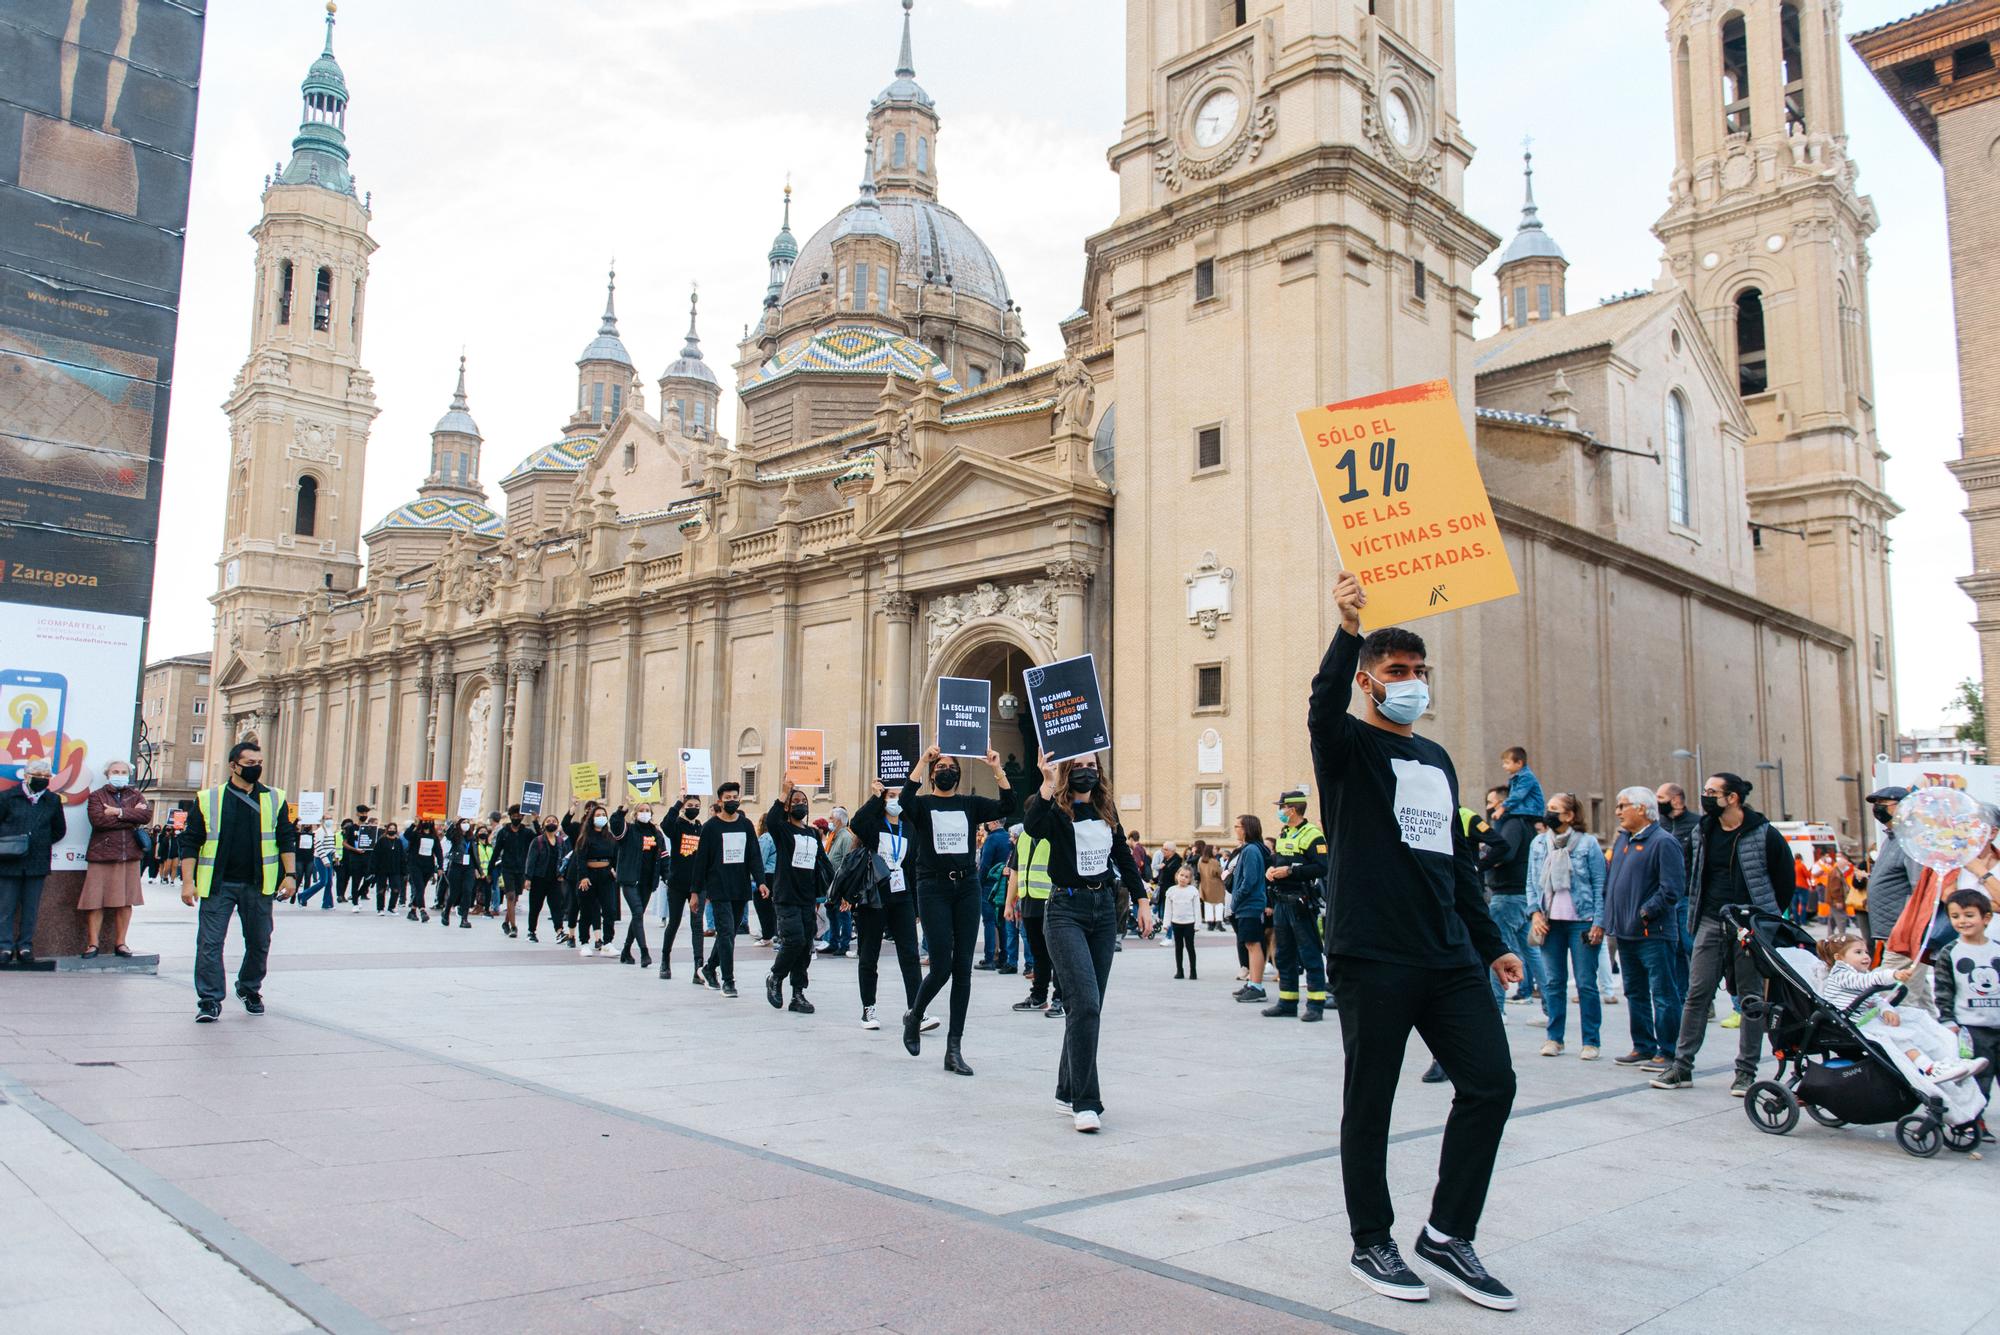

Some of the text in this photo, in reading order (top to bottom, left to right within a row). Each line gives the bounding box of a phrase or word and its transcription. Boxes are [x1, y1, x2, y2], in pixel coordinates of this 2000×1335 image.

[26, 290, 110, 317] www.emoz.es
[1317, 418, 1396, 448] SÓLO EL
[1336, 438, 1409, 503] 1%
[1342, 502, 1411, 529] DE LAS
[1350, 512, 1487, 557] VÍCTIMAS SON
[1360, 543, 1491, 586] RESCATADAS.
[12, 562, 98, 587] Zaragoza
[1048, 690, 1072, 702] CAMINO
[951, 704, 986, 713] ESCLAVITUD
[1042, 704, 1054, 712] POR
[1067, 696, 1085, 706] CHICA
[1060, 706, 1076, 716] AÑOS
[1076, 702, 1088, 711] QUE
[946, 720, 981, 728] EXISTIENDO.
[1044, 713, 1082, 728] ESTÁ SIENDO
[1046, 722, 1082, 736] EXPLOTADA.
[1400, 807, 1441, 820] ABOLIENDO
[1400, 815, 1442, 828] ESCLAVITUD
[1400, 824, 1436, 836] CON CADA
